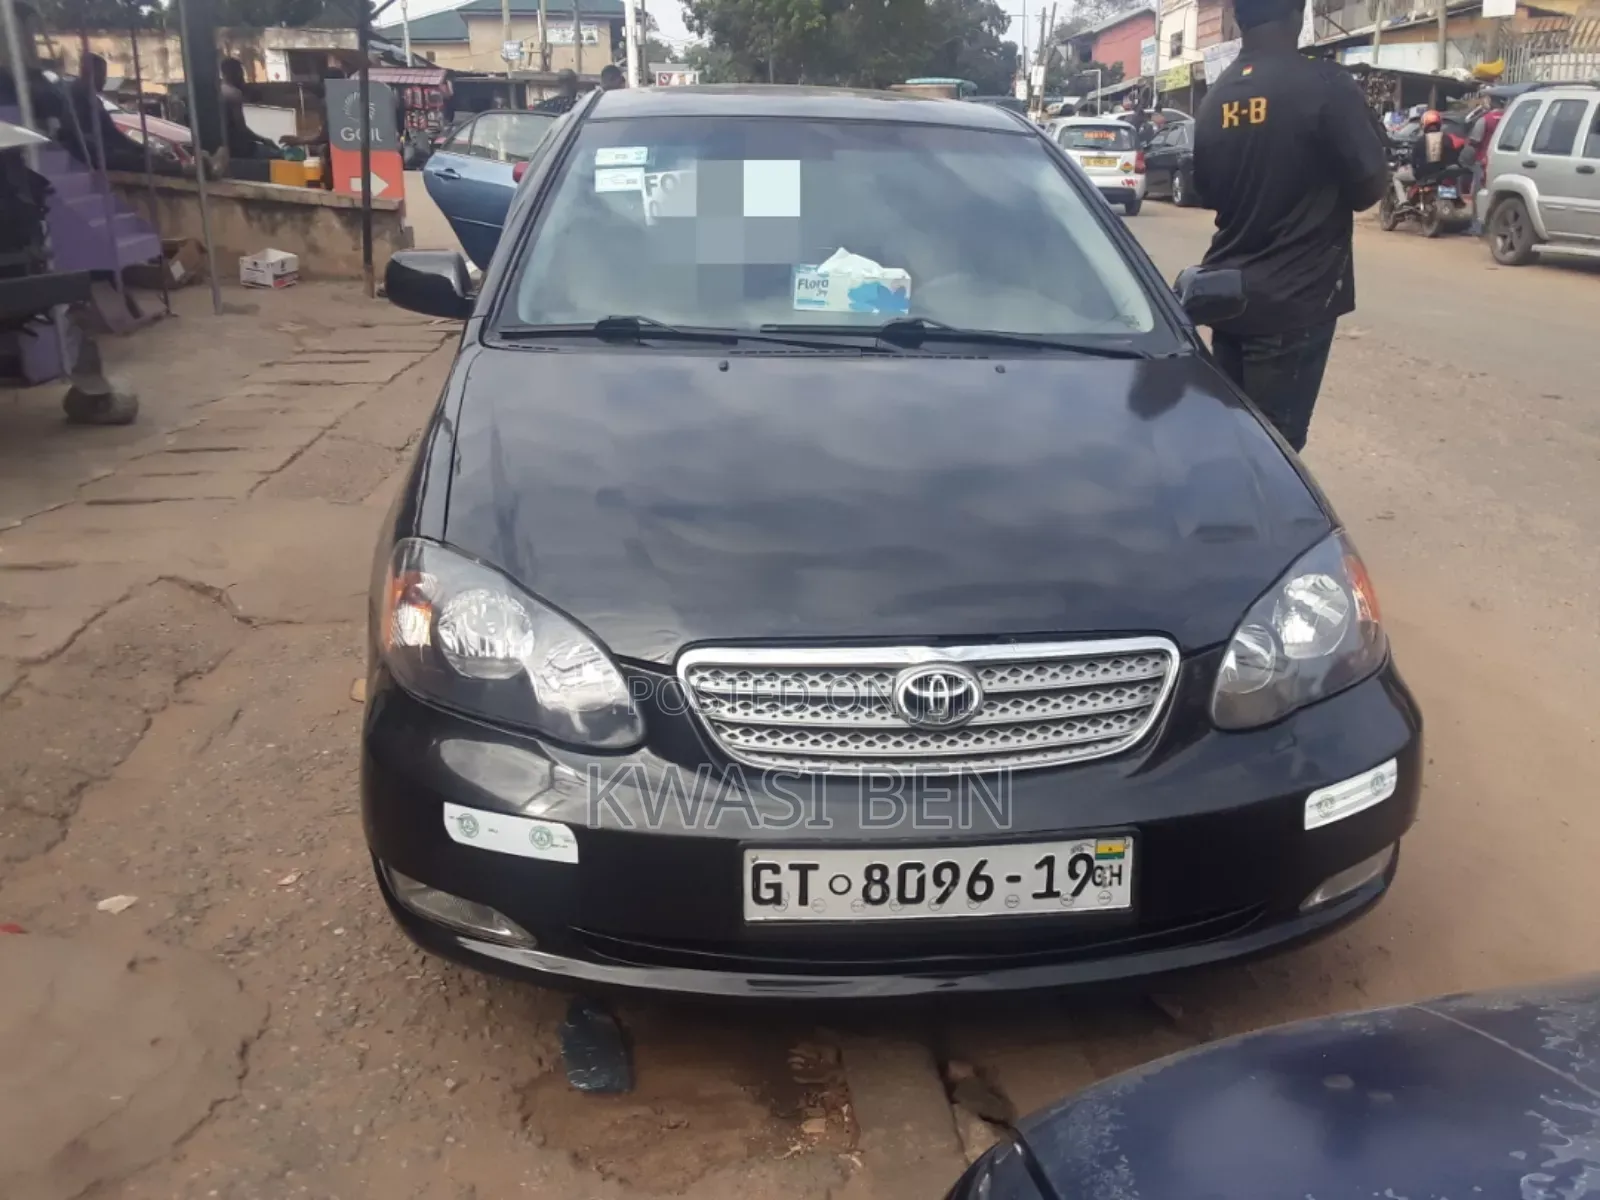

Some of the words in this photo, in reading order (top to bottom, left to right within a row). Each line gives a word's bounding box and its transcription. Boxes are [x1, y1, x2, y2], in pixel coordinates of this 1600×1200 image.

[1222, 97, 1267, 129] K-B
[751, 862, 820, 907] GT
[1092, 864, 1123, 887] GH
